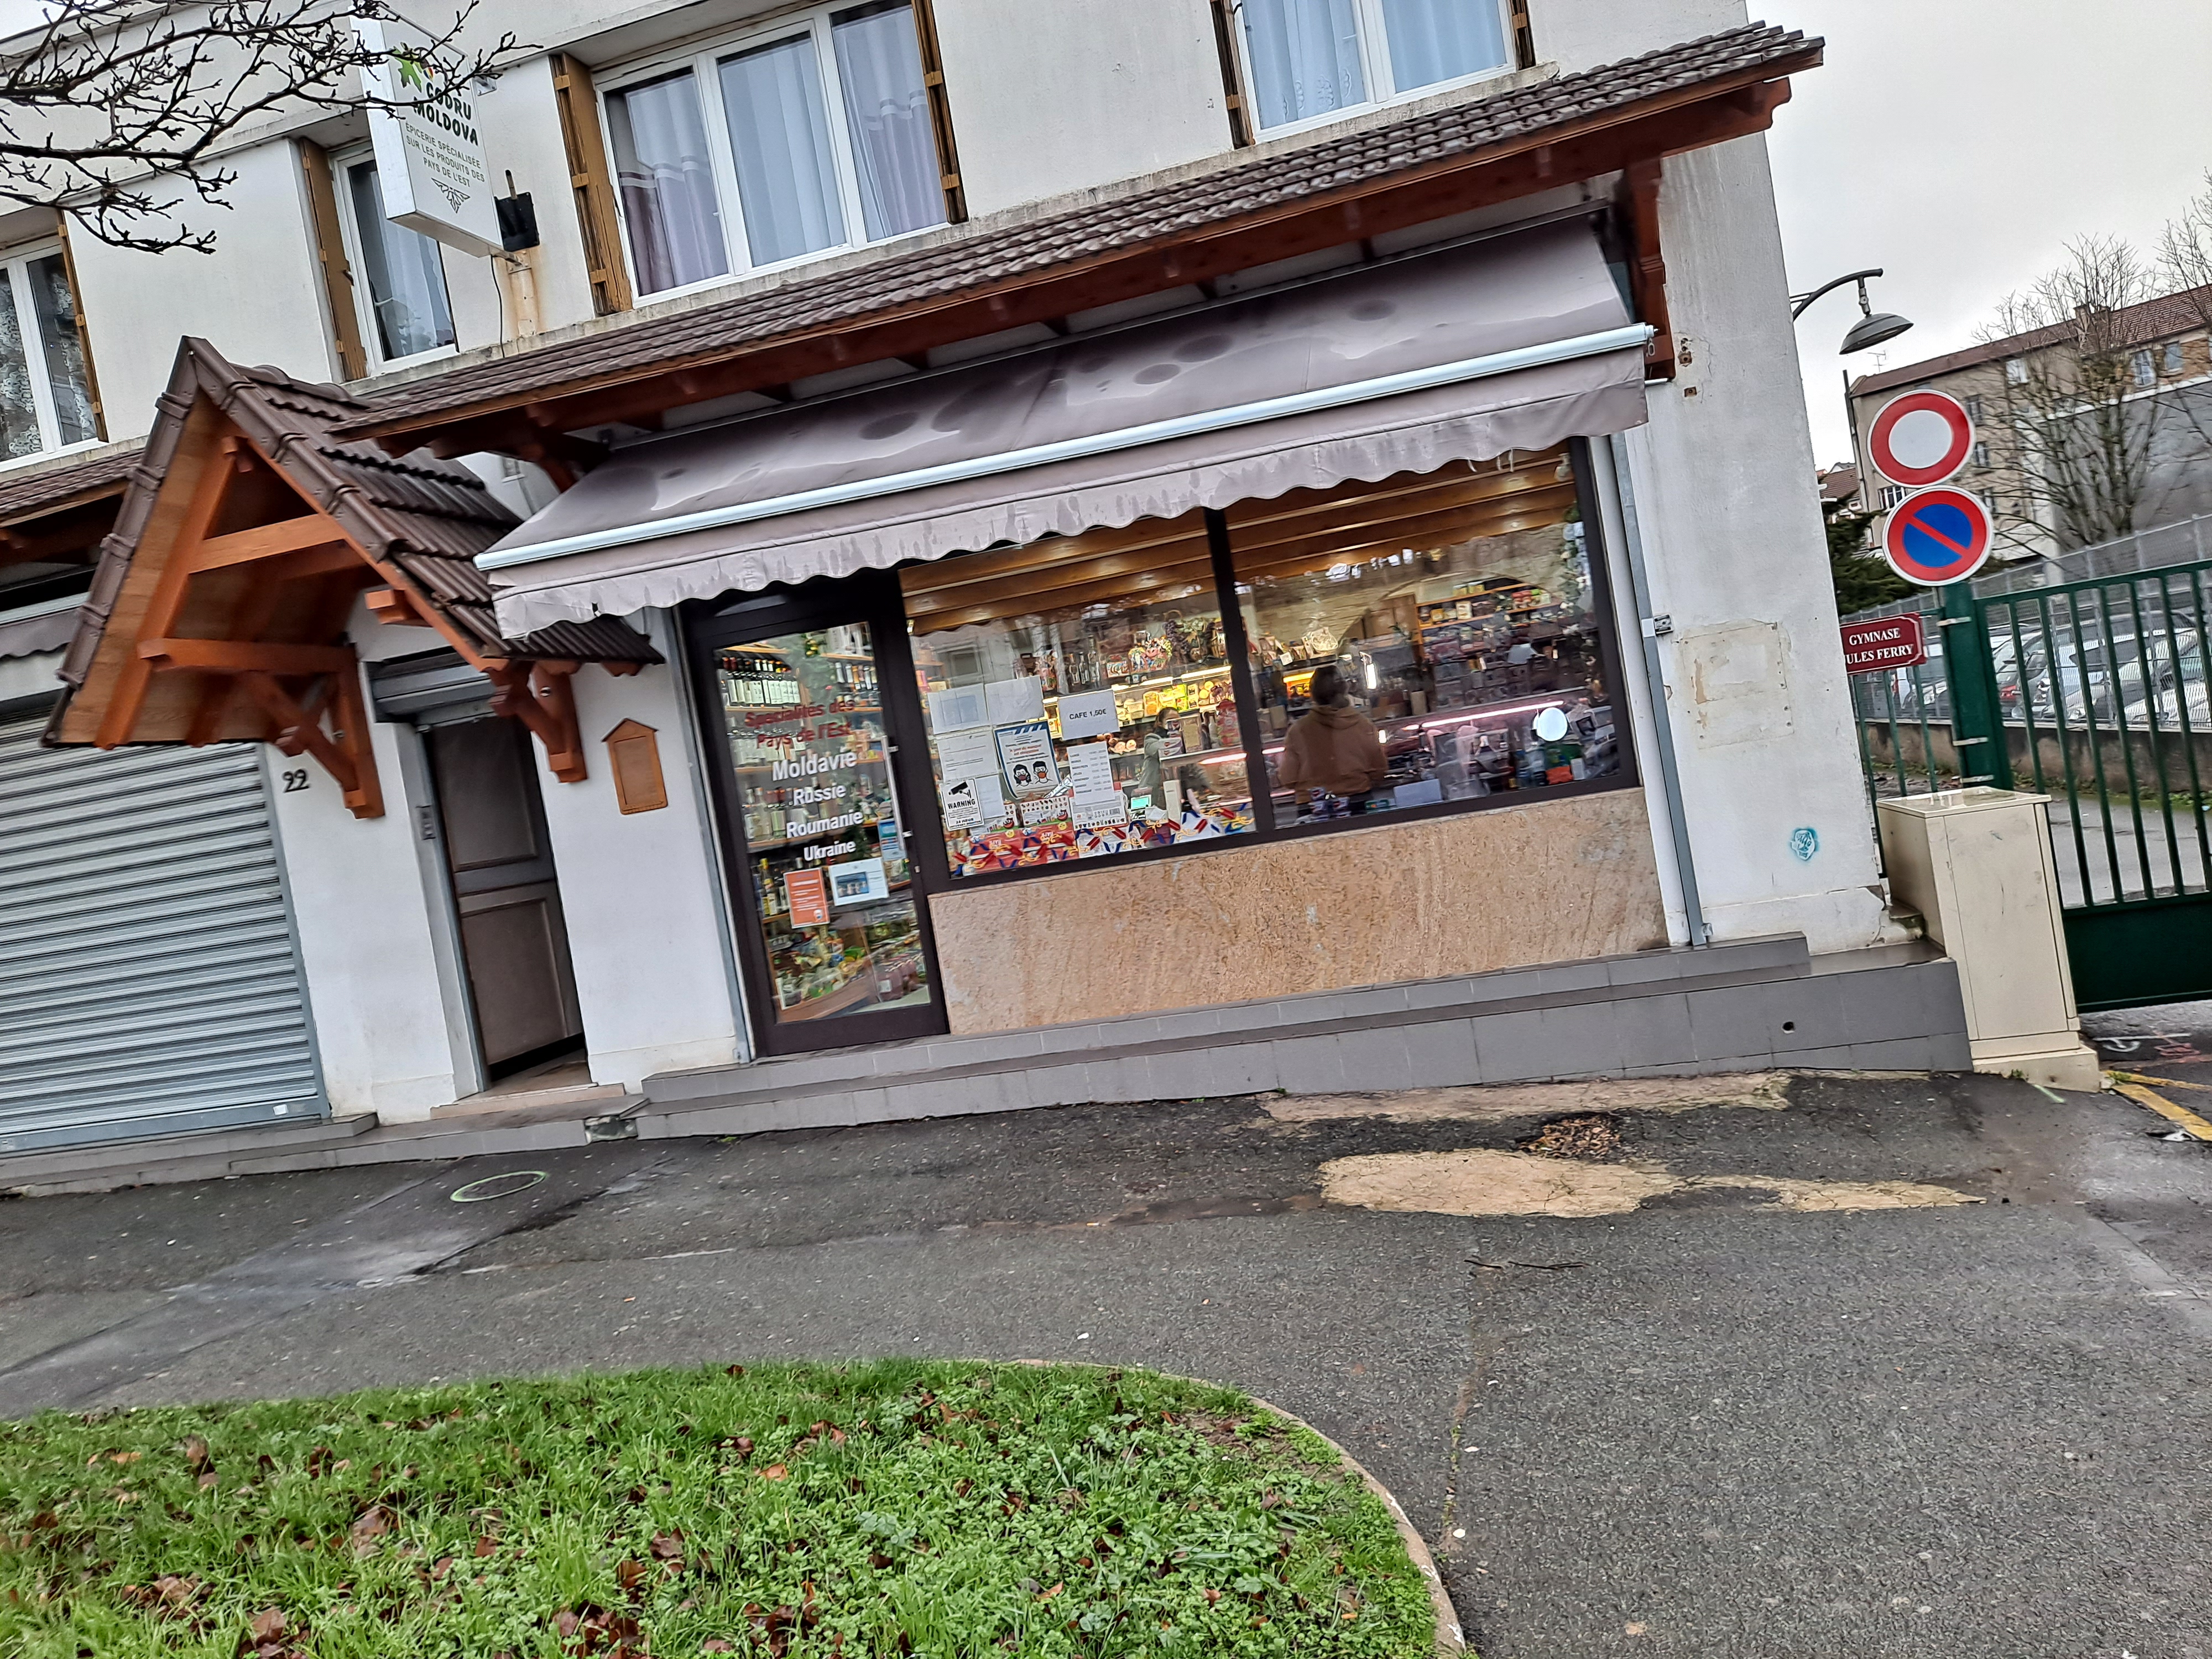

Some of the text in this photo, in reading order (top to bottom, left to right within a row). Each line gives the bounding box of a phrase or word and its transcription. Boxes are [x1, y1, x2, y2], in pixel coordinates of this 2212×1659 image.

[426, 82, 471, 120] CODRU
[405, 121, 481, 169] ÉPICERIE SPÉCIALISÉE
[406, 135, 485, 182] SUR LES PRODUITS DES
[423, 156, 471, 187] PAYS DE L'EST
[1849, 628, 1901, 645] GYMNASE
[1845, 644, 1913, 664] ULES FERRY
[830, 698, 855, 714] des
[1069, 708, 1107, 720] CAFE 1,50€
[757, 733, 792, 750] Pays
[796, 728, 816, 743] de
[772, 752, 858, 781] Moldavie
[282, 769, 310, 793] 22
[793, 782, 847, 806] Russie
[947, 799, 975, 810] WARNING
[786, 808, 864, 839] Roumanie
[804, 841, 857, 862] Ukraine
